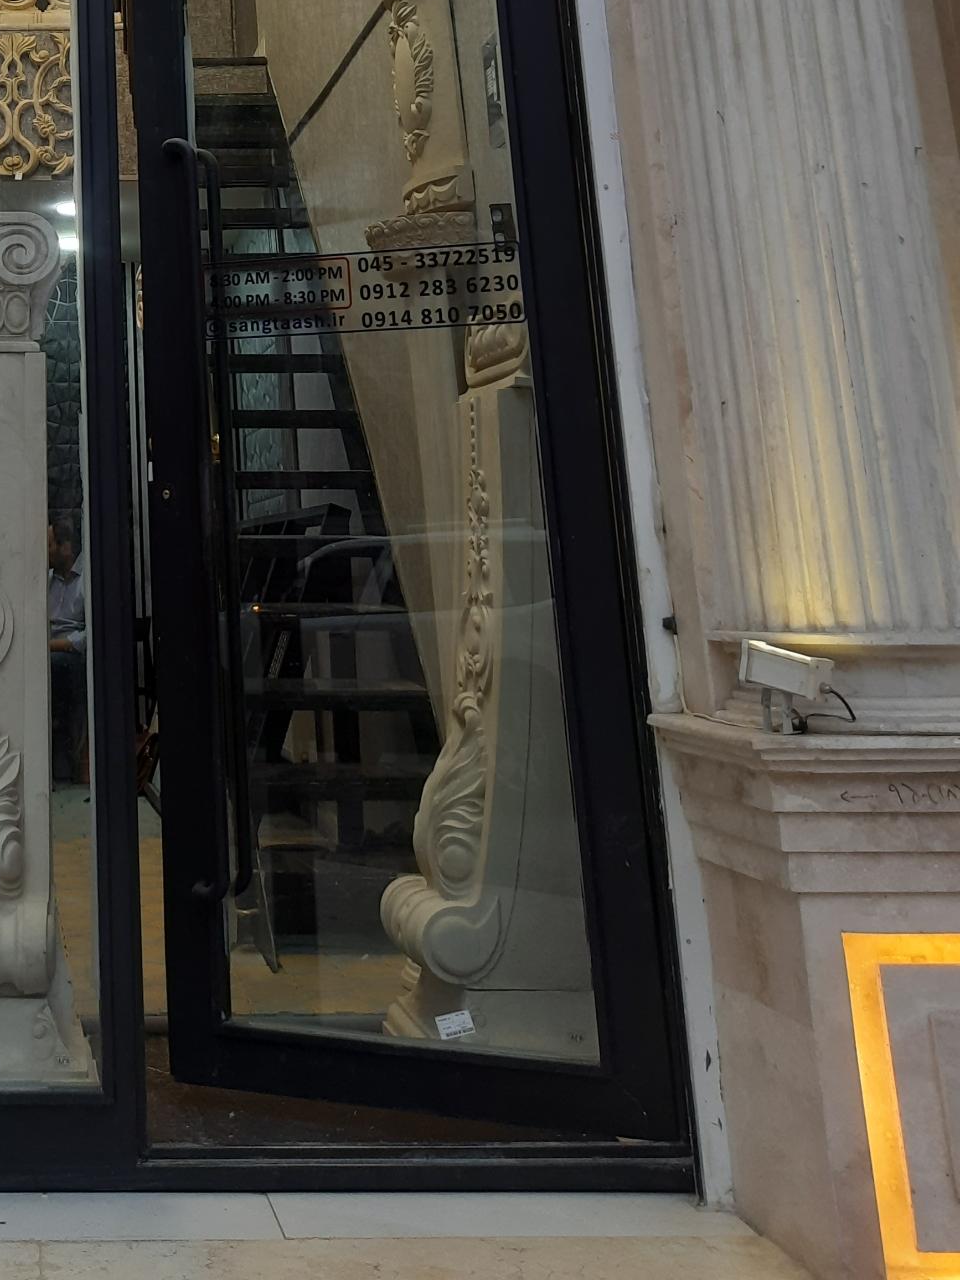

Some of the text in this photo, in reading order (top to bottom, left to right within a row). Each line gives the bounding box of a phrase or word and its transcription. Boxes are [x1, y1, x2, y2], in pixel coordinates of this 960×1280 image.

[358, 255, 393, 273] 045
[415, 246, 515, 269] 33722519
[244, 271, 269, 285] AM
[282, 269, 313, 283] 2:00
[318, 266, 343, 280] PM
[360, 274, 519, 301] 0912 283 6230
[246, 294, 270, 307] PM
[284, 290, 316, 305] 8:30
[320, 288, 345, 302] PM
[362, 303, 522, 328] 0914 810 7050
